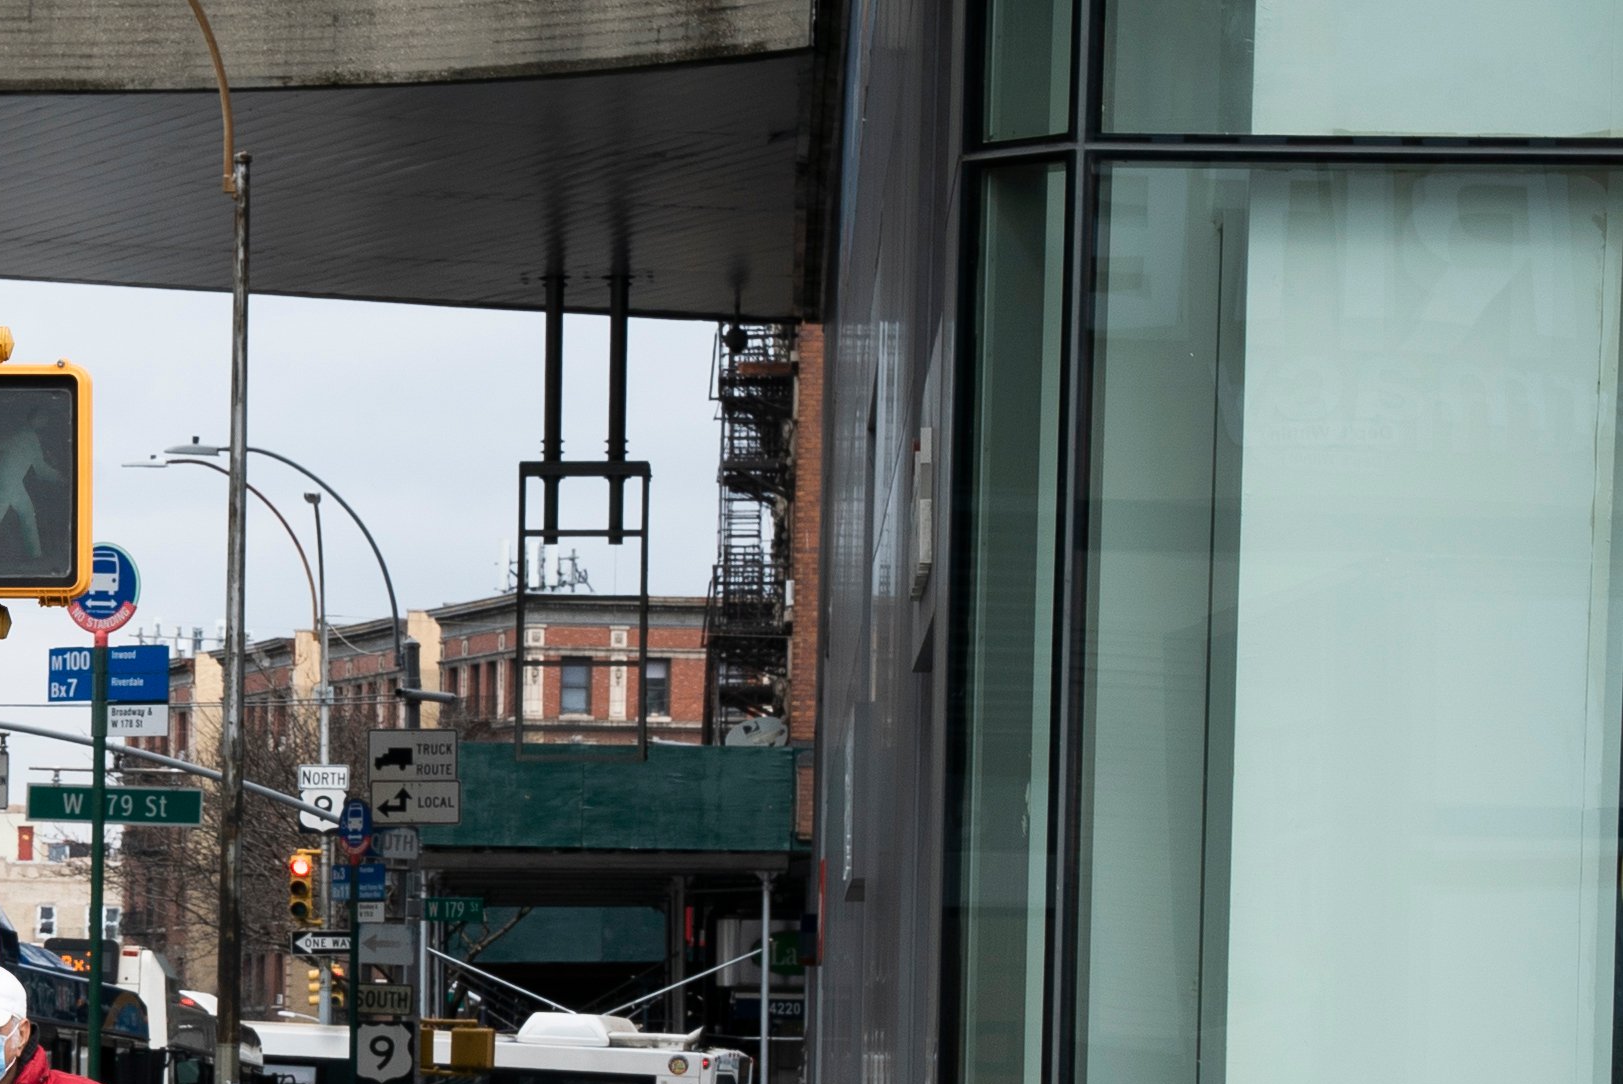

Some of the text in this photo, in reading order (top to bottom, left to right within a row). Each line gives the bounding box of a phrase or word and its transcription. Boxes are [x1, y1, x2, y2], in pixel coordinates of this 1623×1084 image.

[72, 607, 130, 629] NO STANDING
[51, 651, 90, 671] M100
[50, 678, 78, 698] Bx7
[111, 676, 144, 687] Riverdale
[111, 707, 145, 718] Broadway
[111, 720, 120, 729] W
[136, 719, 143, 729] St
[416, 743, 453, 756] TRUCK
[416, 763, 453, 776] ROUTE
[302, 770, 346, 786] NORTH
[63, 793, 168, 818] W 79 St
[417, 797, 455, 809] LOCAL
[372, 833, 414, 851] OUTH
[428, 901, 439, 917] W
[445, 901, 465, 918] 179
[304, 938, 351, 948] ONE WAY
[770, 940, 798, 965] La
[358, 990, 408, 1009] SOUTH
[768, 1002, 801, 1015] 4220
[369, 1035, 395, 1071] 9
